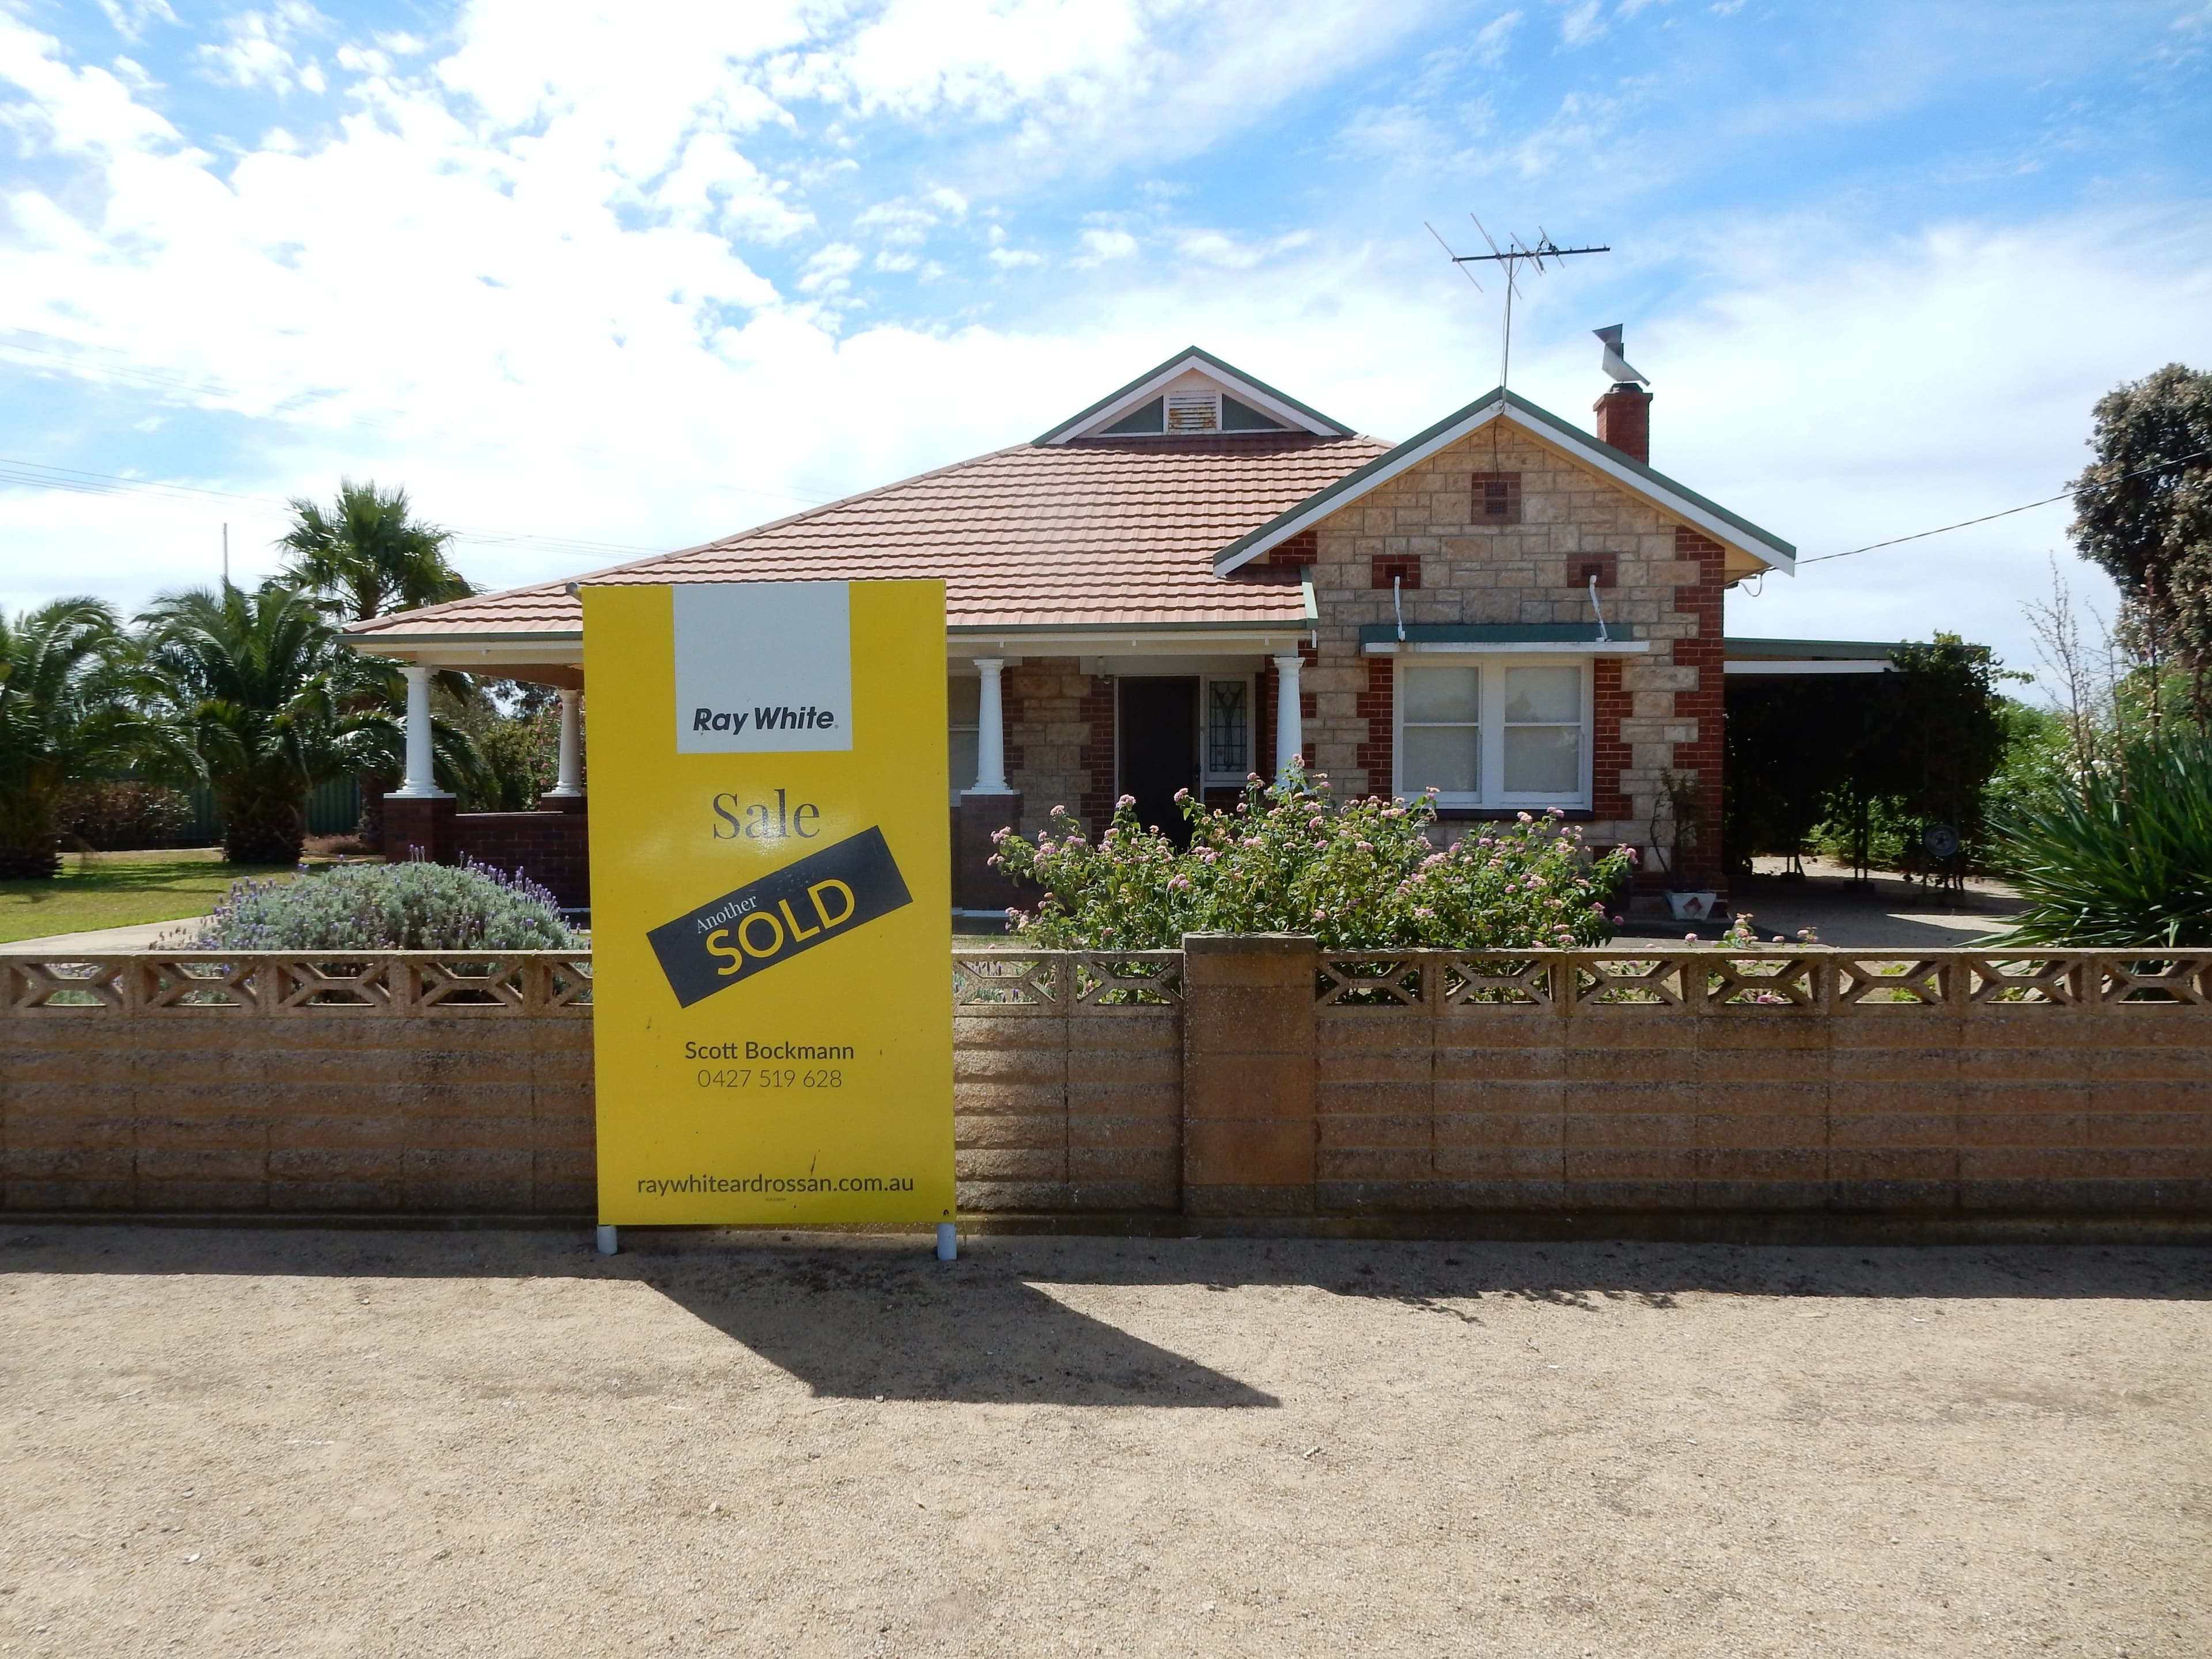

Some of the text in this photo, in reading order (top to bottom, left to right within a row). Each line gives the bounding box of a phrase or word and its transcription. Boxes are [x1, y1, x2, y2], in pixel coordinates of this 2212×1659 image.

[693, 707, 834, 735] Ray White
[713, 788, 820, 839] Sale
[696, 894, 757, 934] Another
[706, 879, 856, 976] SOLD
[685, 1041, 854, 1059] Scott Bockmann
[698, 1070, 842, 1088] 0427 519 628
[638, 1174, 914, 1196] raywhiteardrossan.com.au
